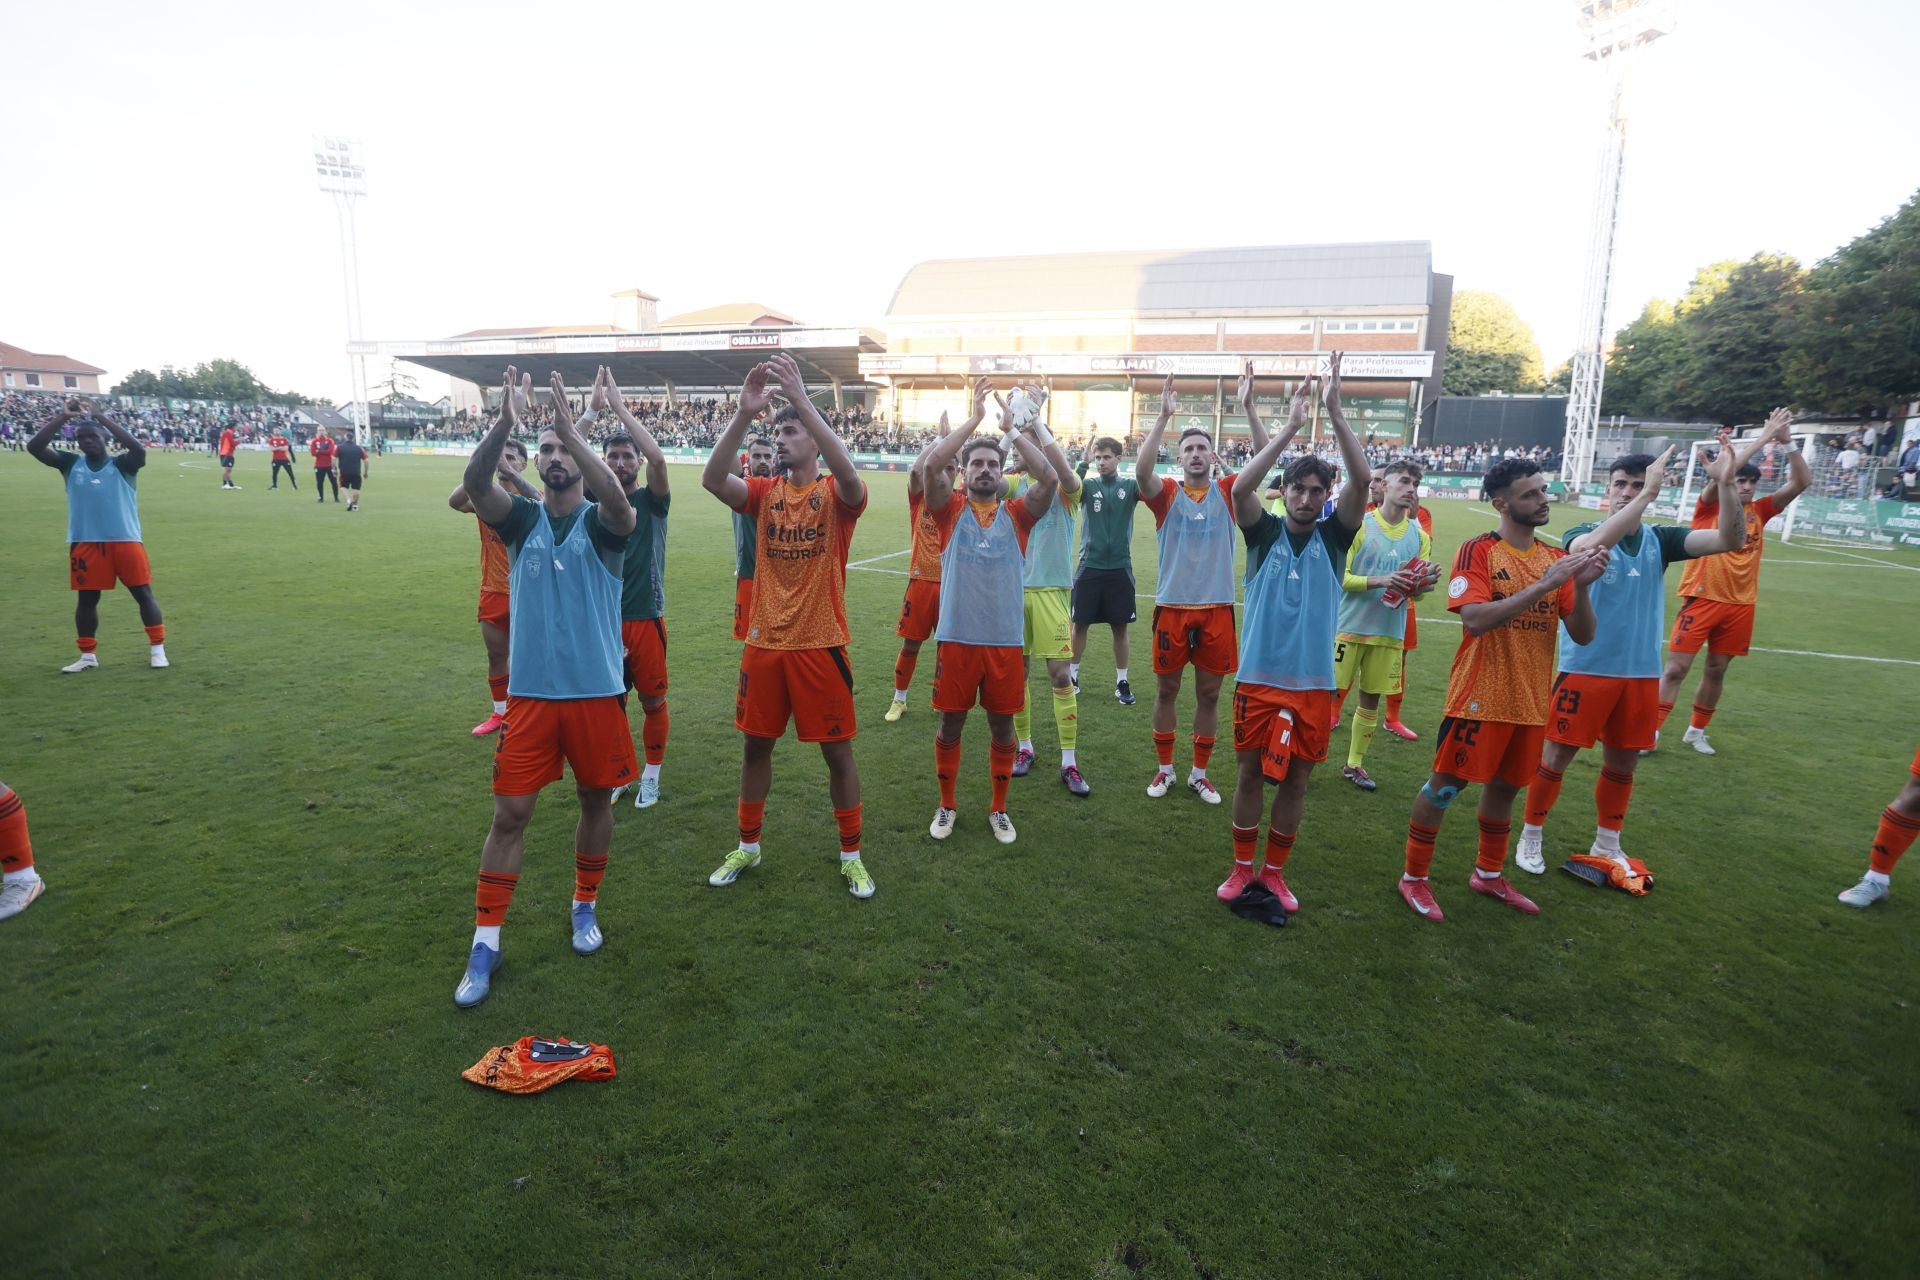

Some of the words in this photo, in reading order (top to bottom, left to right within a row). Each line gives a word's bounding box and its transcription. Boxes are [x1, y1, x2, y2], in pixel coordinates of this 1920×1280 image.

[618, 338, 659, 349] OBRAMAT
[732, 335, 779, 346] OBRAMAT
[1366, 357, 1427, 366] Profesionales
[1351, 367, 1404, 375] Particulares
[71, 557, 87, 572] 24
[1680, 615, 1695, 631] 12
[1158, 630, 1171, 651] 16
[1556, 688, 1582, 714] 23
[1454, 718, 1482, 747] 22
